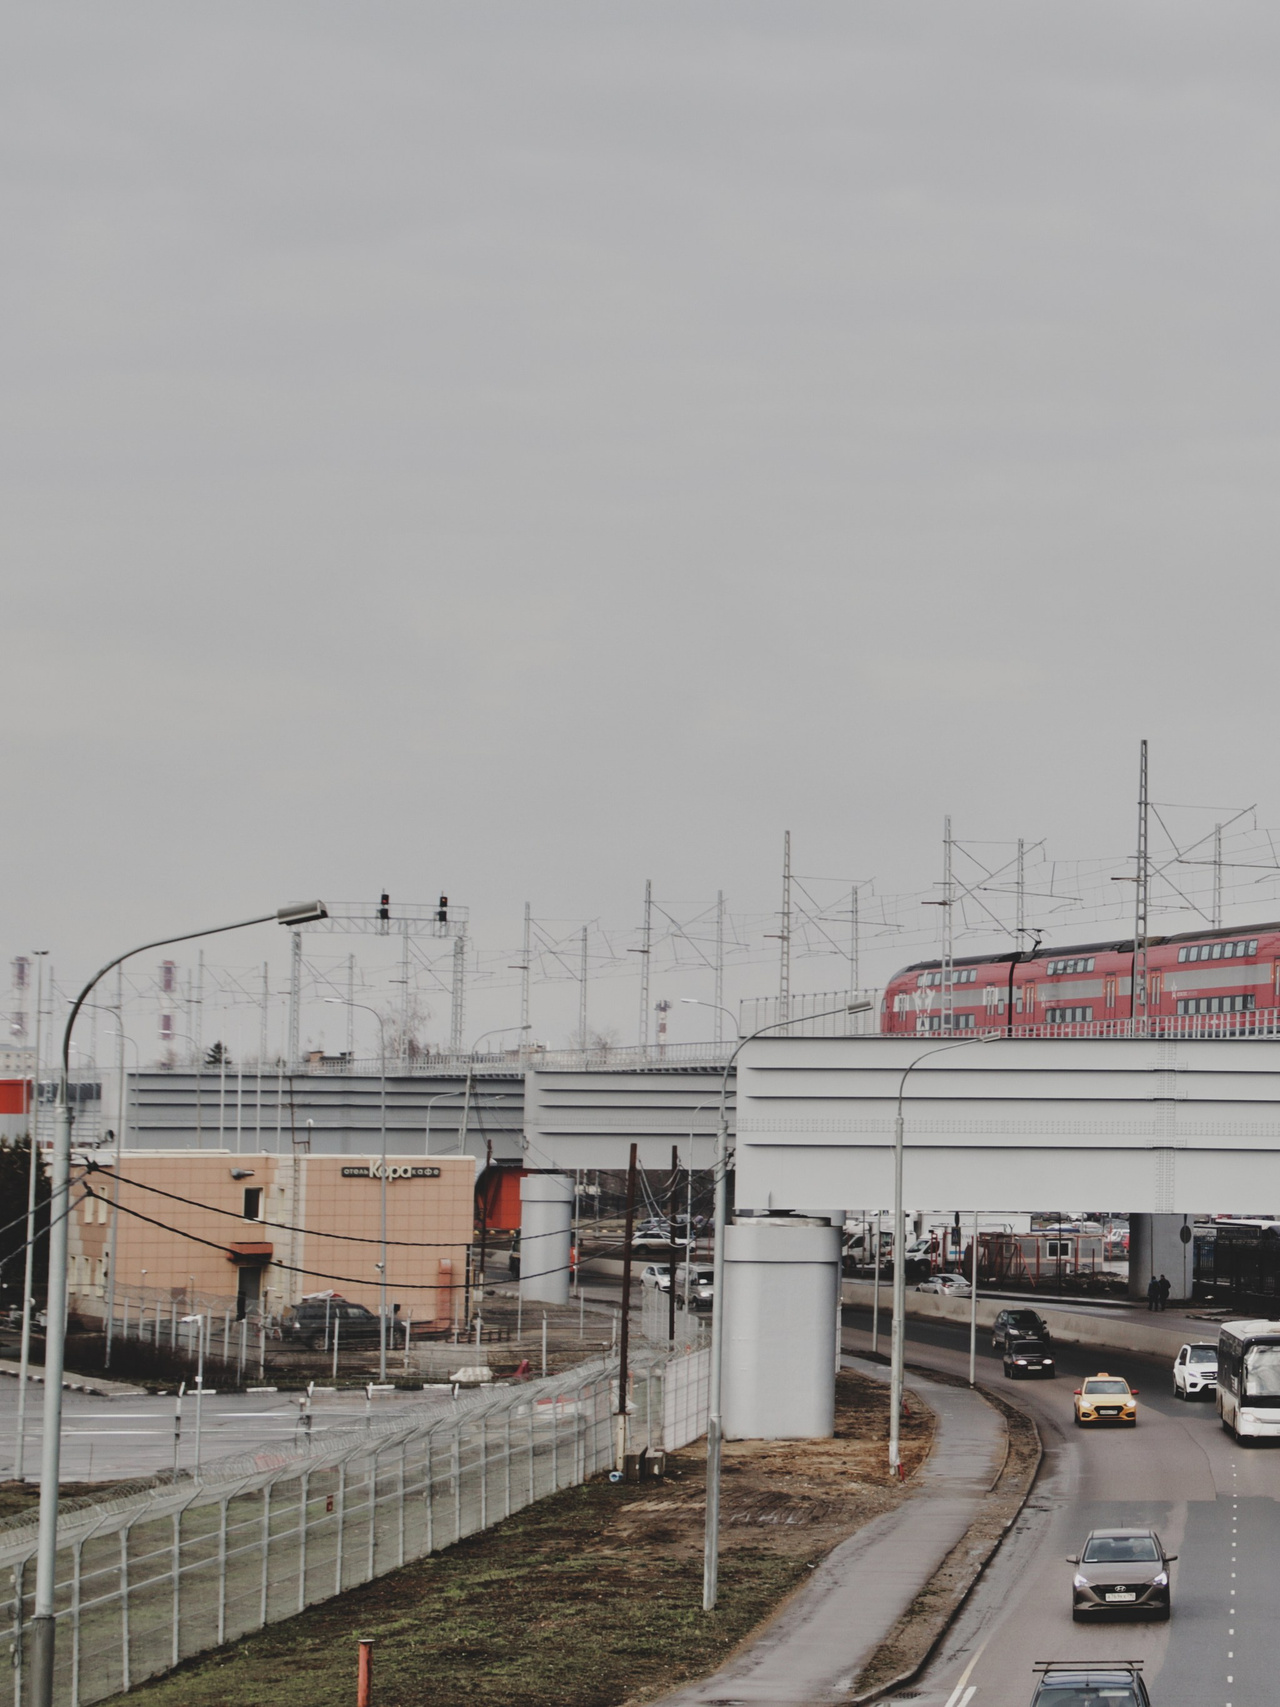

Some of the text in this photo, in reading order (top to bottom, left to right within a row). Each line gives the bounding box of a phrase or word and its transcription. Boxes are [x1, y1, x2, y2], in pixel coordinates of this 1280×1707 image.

[343, 1159, 440, 1182] отель Кора кафе
